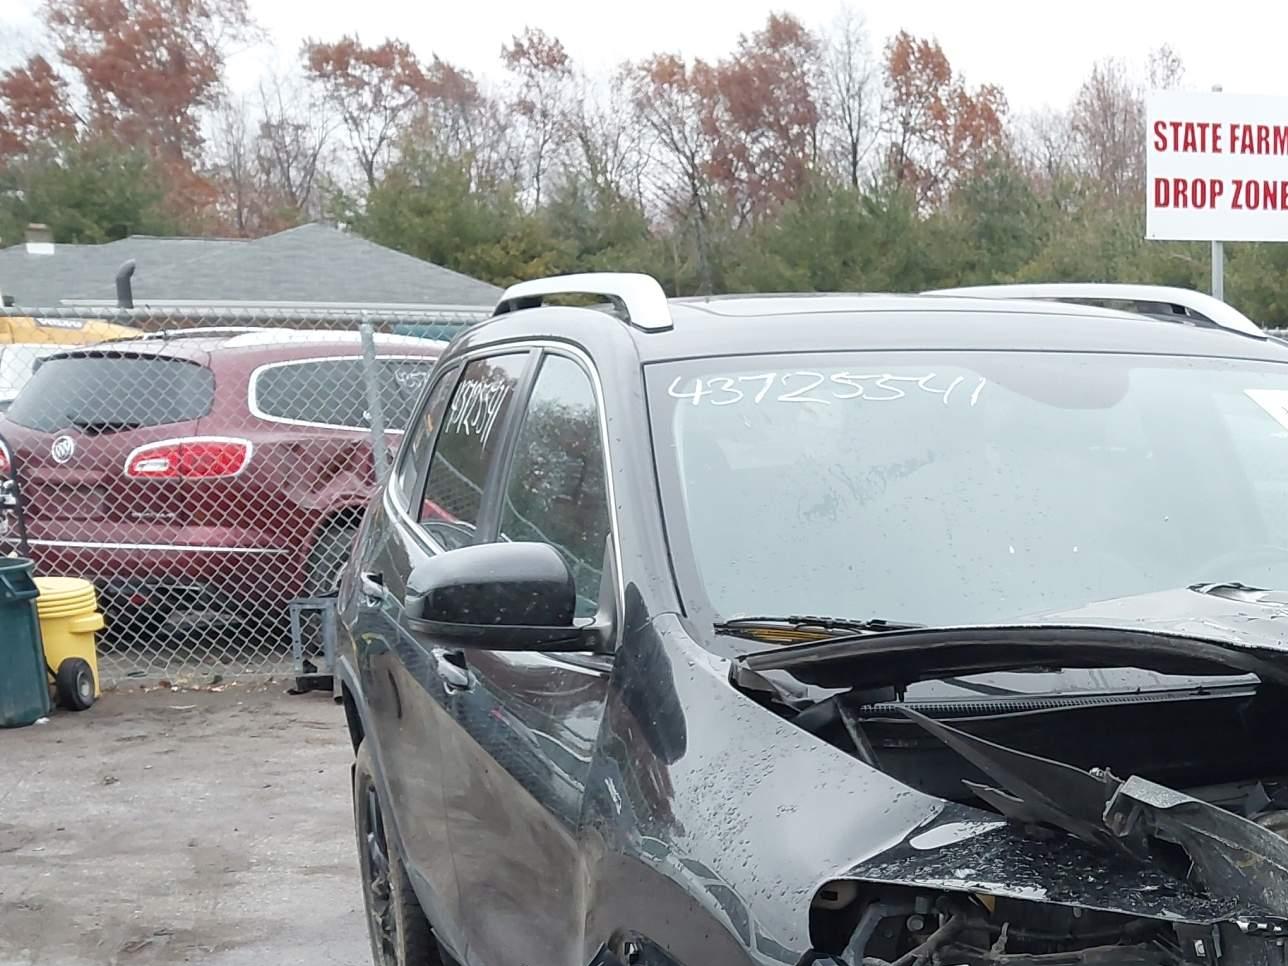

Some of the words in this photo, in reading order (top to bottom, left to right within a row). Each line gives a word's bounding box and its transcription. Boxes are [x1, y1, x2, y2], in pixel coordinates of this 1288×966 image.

[1154, 121, 1222, 153] STATE
[1154, 178, 1223, 209] DROP
[668, 372, 986, 406] 43725541
